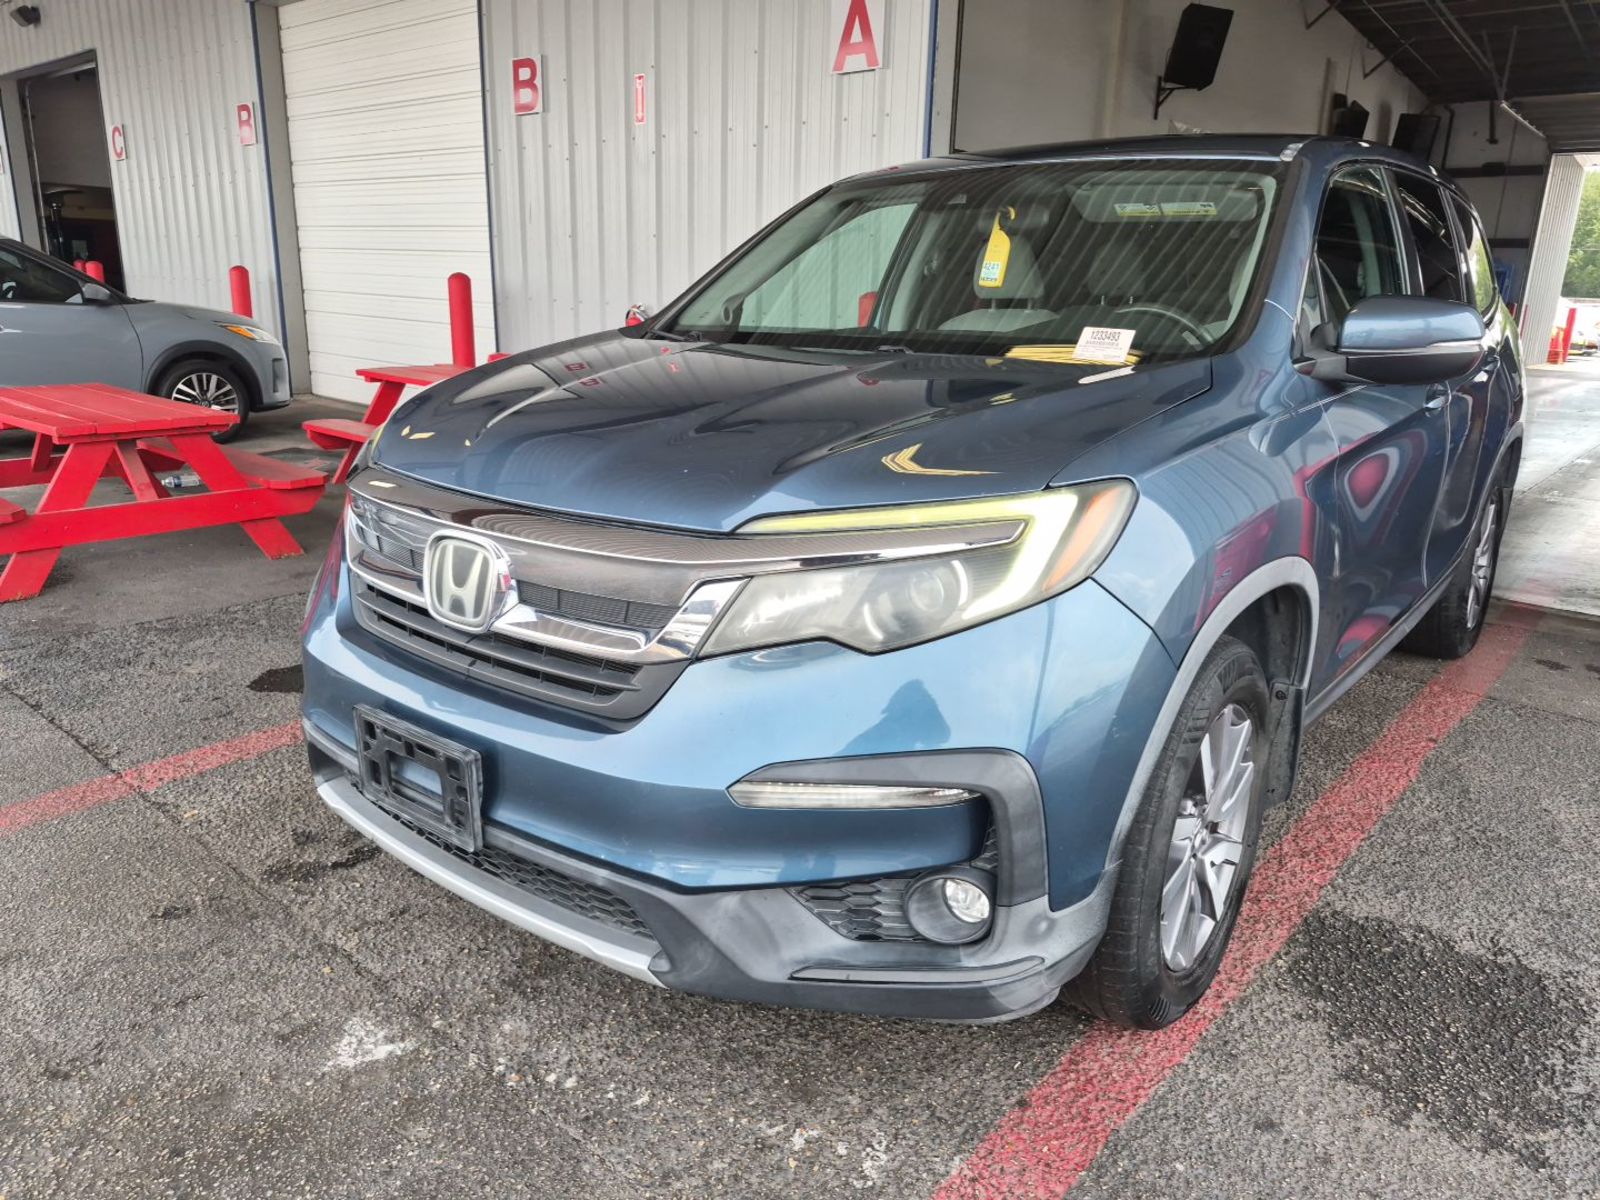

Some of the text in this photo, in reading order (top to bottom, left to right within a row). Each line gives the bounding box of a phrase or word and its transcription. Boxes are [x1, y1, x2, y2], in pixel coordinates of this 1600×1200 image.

[832, 0, 879, 71] A
[512, 57, 539, 113] B
[112, 126, 123, 158] C
[1090, 330, 1121, 341] 1233493
